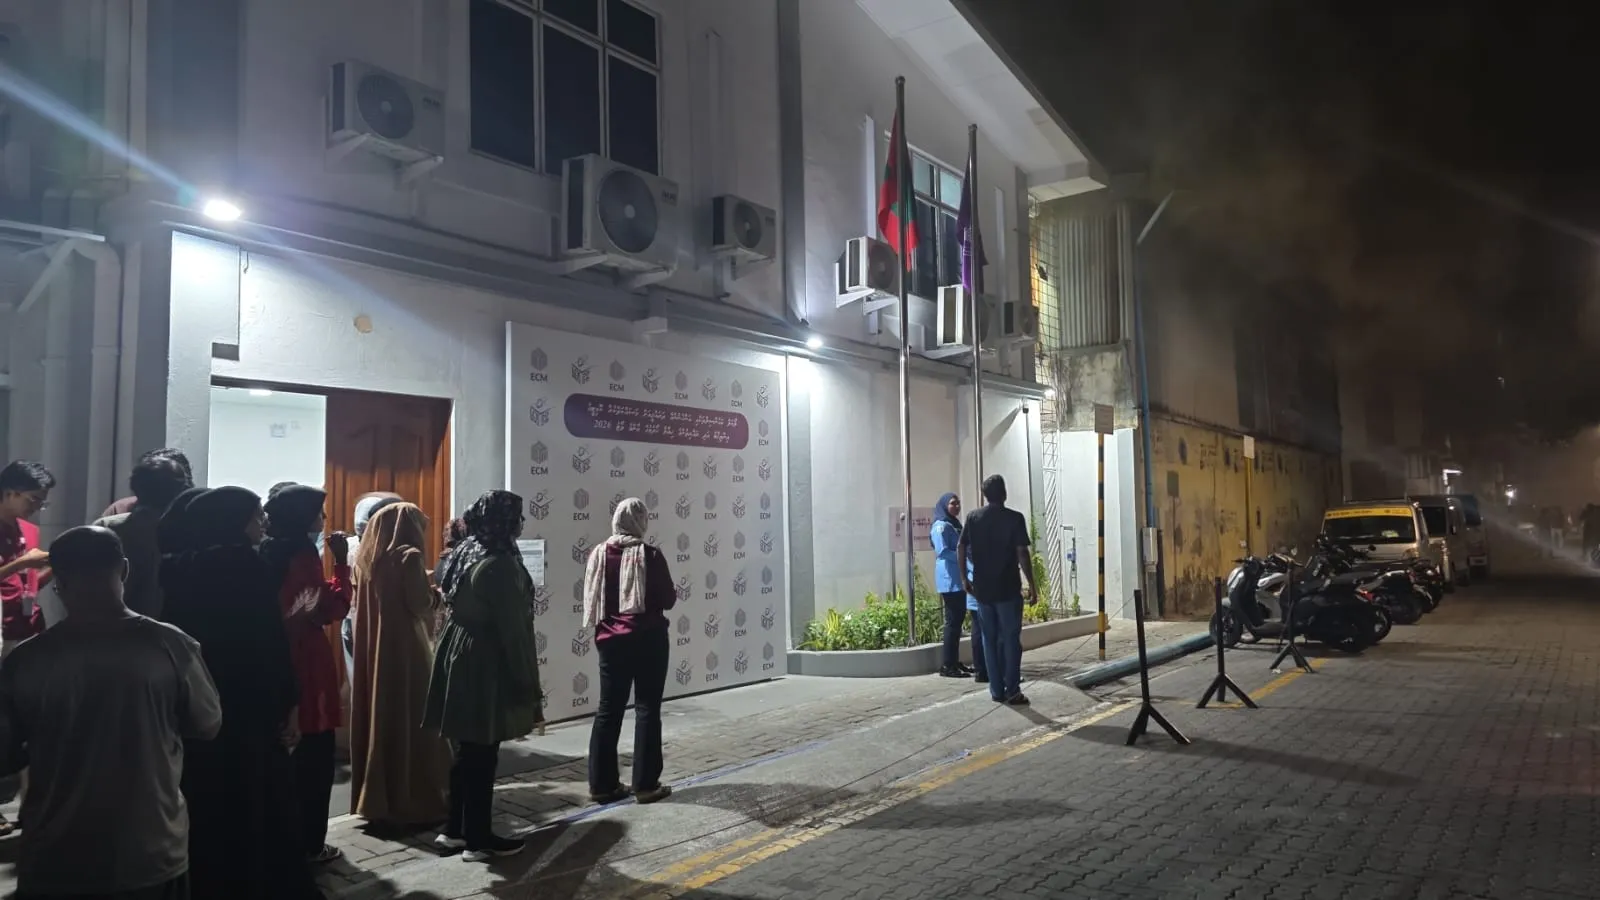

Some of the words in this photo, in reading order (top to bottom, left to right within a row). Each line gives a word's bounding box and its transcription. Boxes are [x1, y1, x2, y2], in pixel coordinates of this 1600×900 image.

[530, 372, 548, 382] ECM
[609, 383, 624, 391] ECM
[674, 392, 688, 400] ECM
[731, 400, 742, 408] ECM
[531, 466, 548, 475] ECM
[648, 512, 659, 520] CM
[677, 554, 690, 563] ECM
[761, 586, 772, 594] ECM
[705, 592, 717, 600] ECM
[735, 629, 746, 637] ECM
[677, 637, 690, 646] ECM
[763, 662, 774, 670] ECM
[706, 673, 718, 682] ECM
[572, 697, 588, 707] ECM
